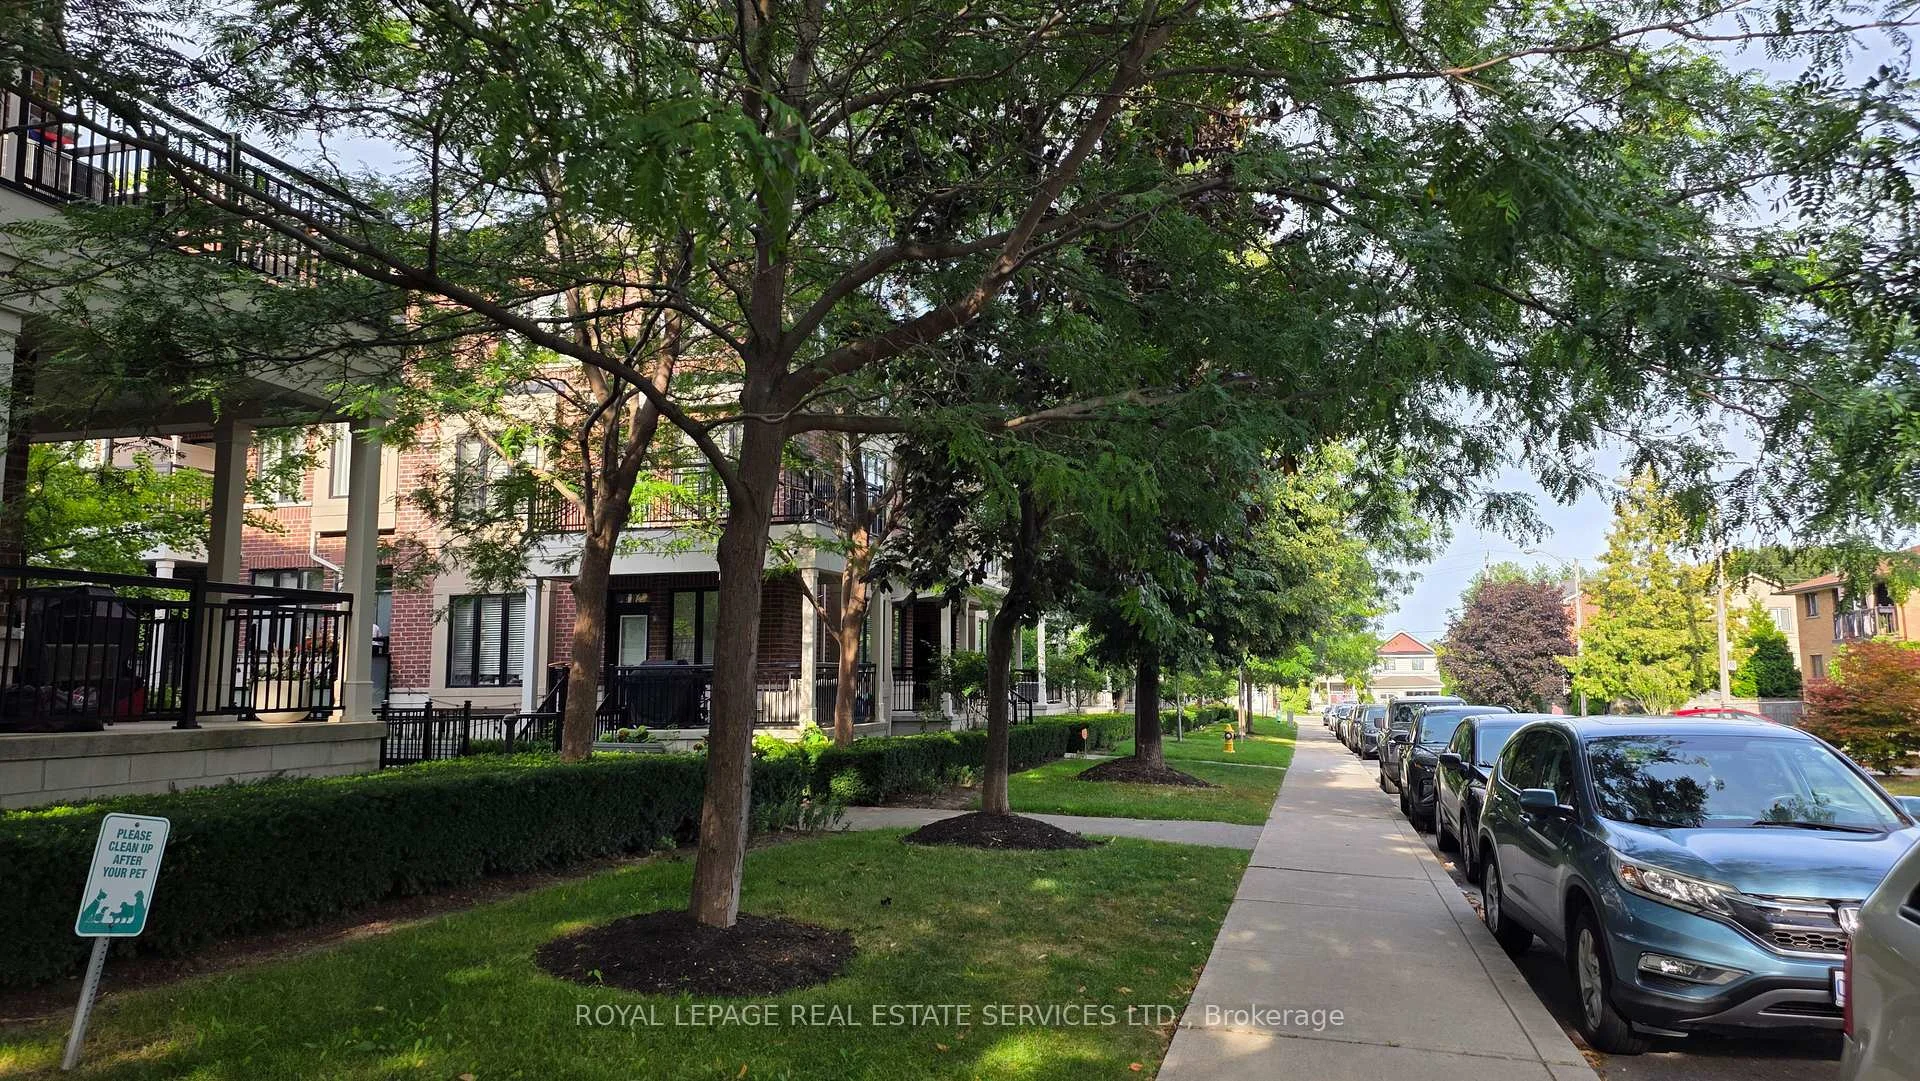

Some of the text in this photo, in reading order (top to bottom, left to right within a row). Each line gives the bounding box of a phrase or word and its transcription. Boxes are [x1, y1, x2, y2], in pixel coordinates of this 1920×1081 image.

[117, 828, 152, 841] PLEASE
[108, 841, 153, 854] CLEAN UP
[112, 854, 143, 865] AFTER
[103, 867, 148, 879] YOUR PET
